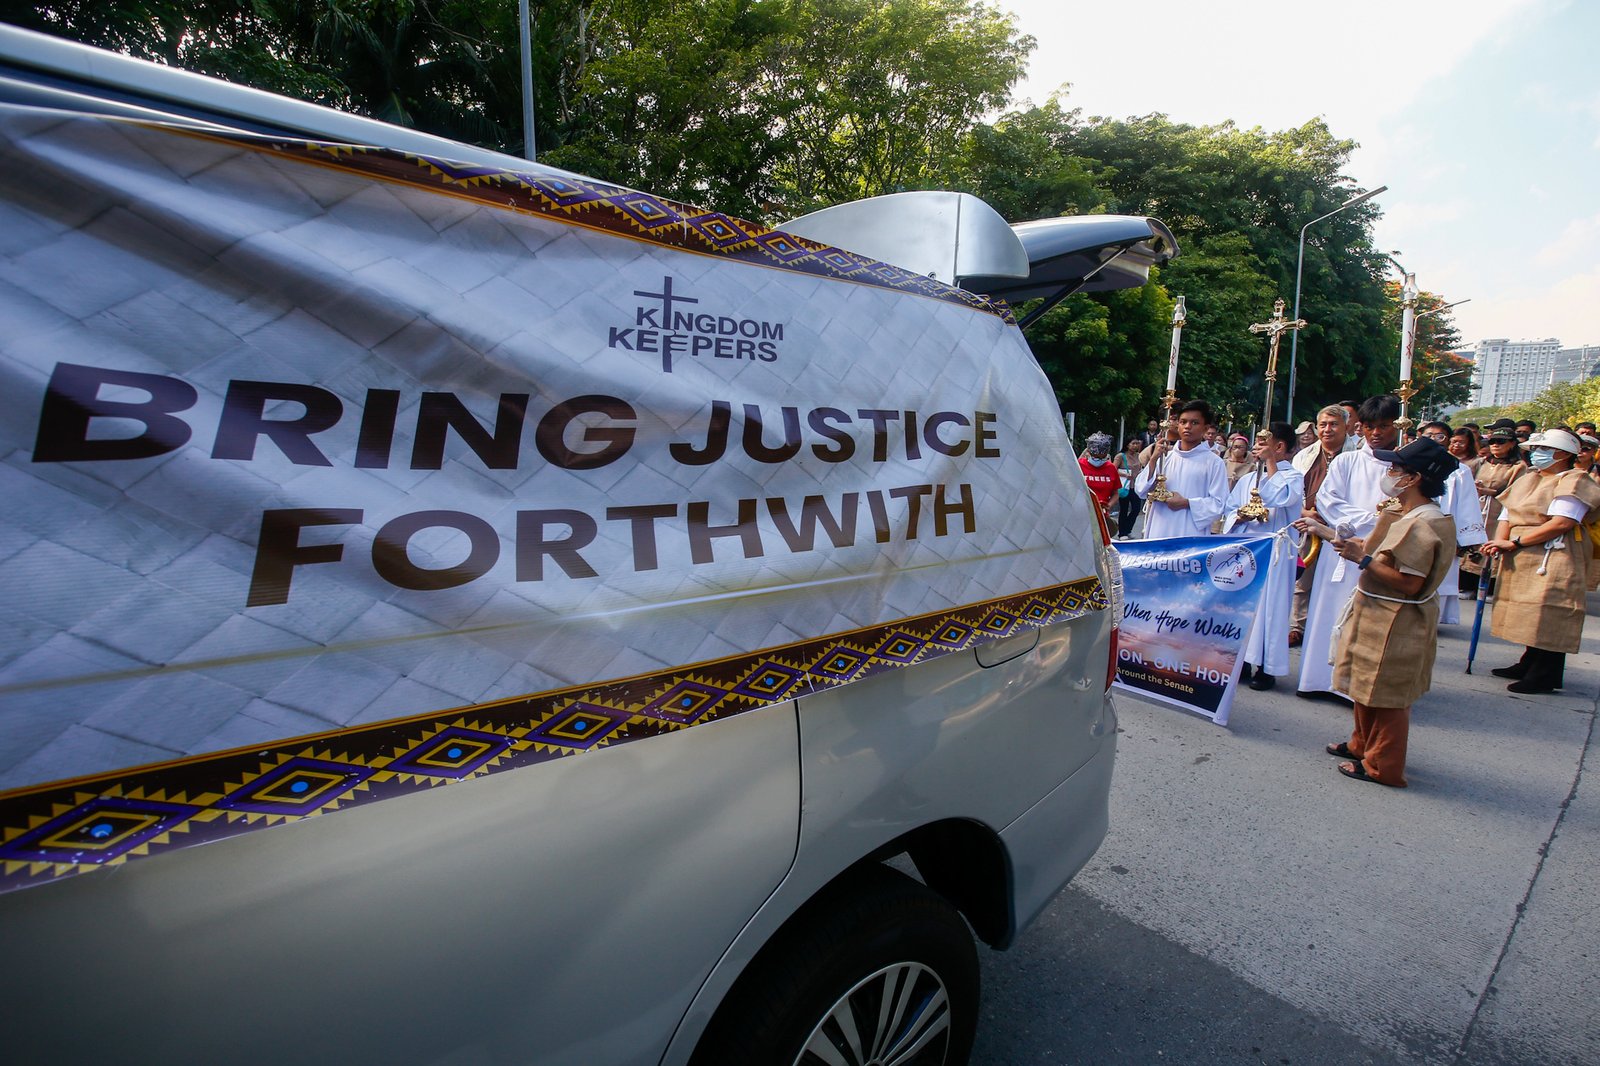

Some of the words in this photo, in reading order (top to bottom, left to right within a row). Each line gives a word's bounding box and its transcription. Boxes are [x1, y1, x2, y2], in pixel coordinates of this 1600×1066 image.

[635, 305, 785, 342] KINGDOM
[607, 325, 778, 364] KEEPERS
[31, 361, 638, 471] BRING
[668, 400, 1001, 466] JUSTICE
[246, 483, 977, 608] FORTHWITH
[1155, 610, 1190, 633] Hope
[1194, 617, 1242, 640] Walks
[1116, 666, 1146, 681] Around
[1148, 673, 1162, 685] the
[1164, 678, 1194, 694] Senate
[1154, 656, 1190, 676] ONE
